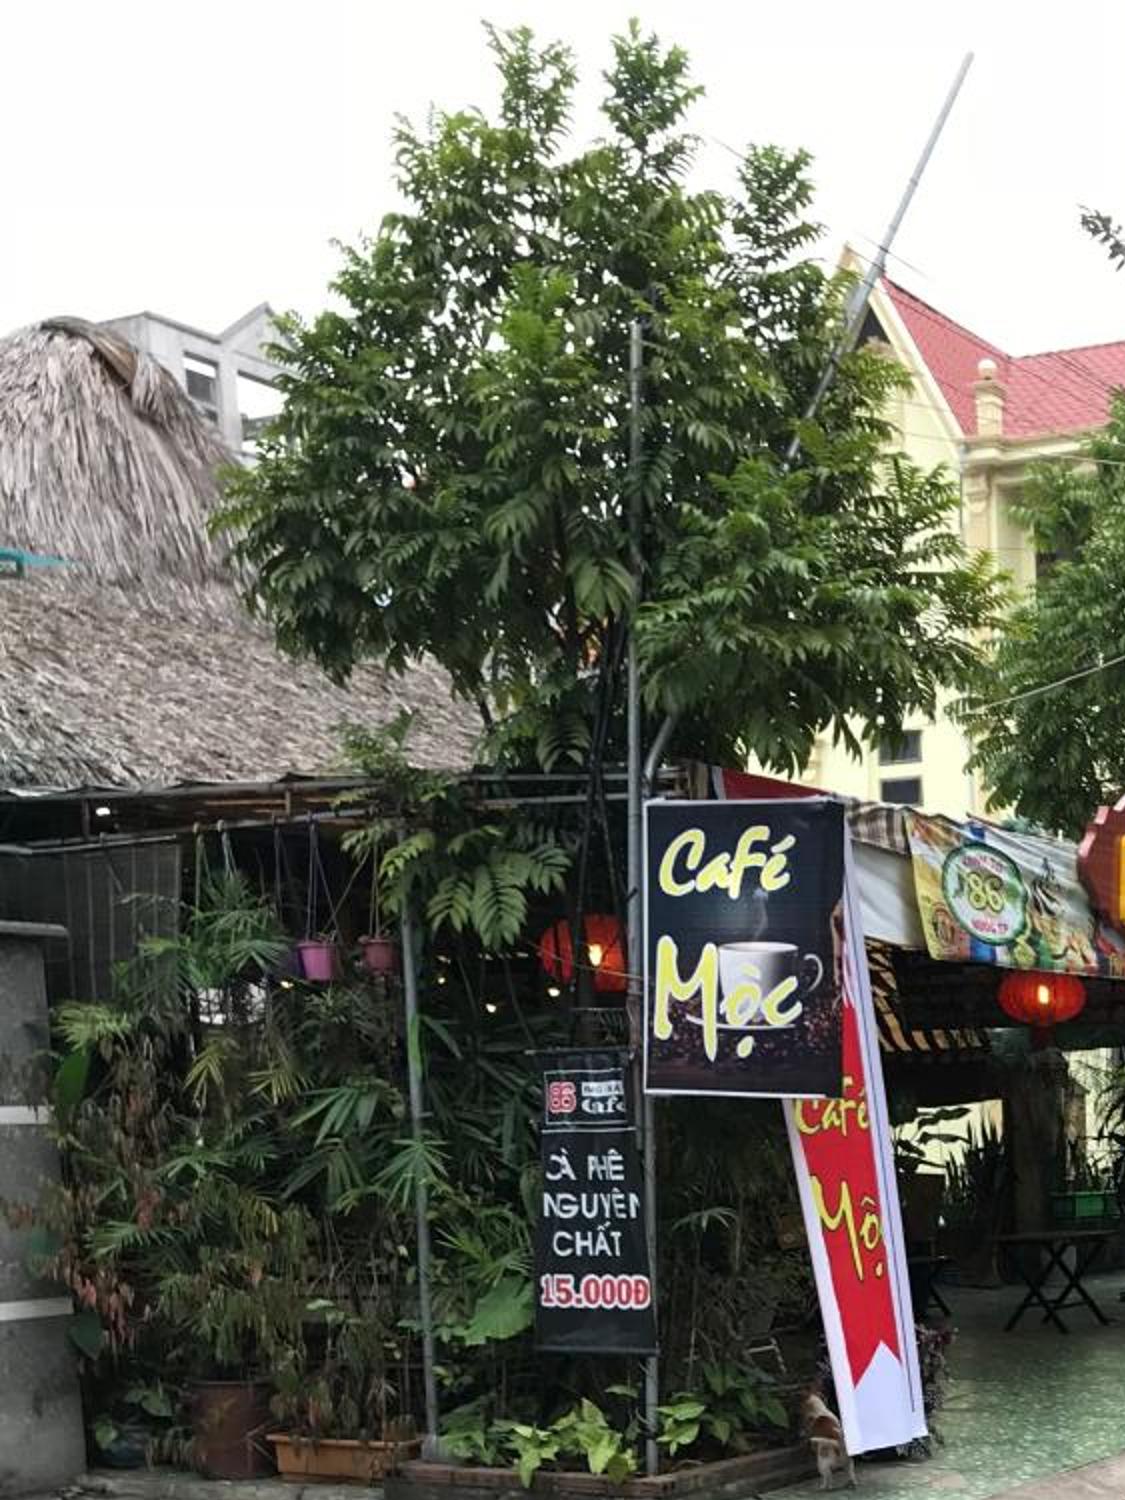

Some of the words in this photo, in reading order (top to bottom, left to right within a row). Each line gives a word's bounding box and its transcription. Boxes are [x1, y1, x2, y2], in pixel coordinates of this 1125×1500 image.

[659, 825, 796, 899] Café
[967, 871, 1005, 913] 86
[654, 935, 802, 1062] Mộc
[549, 1081, 577, 1113] 86
[587, 1148, 624, 1181] PHÊ
[553, 1221, 622, 1257] CHẤT
